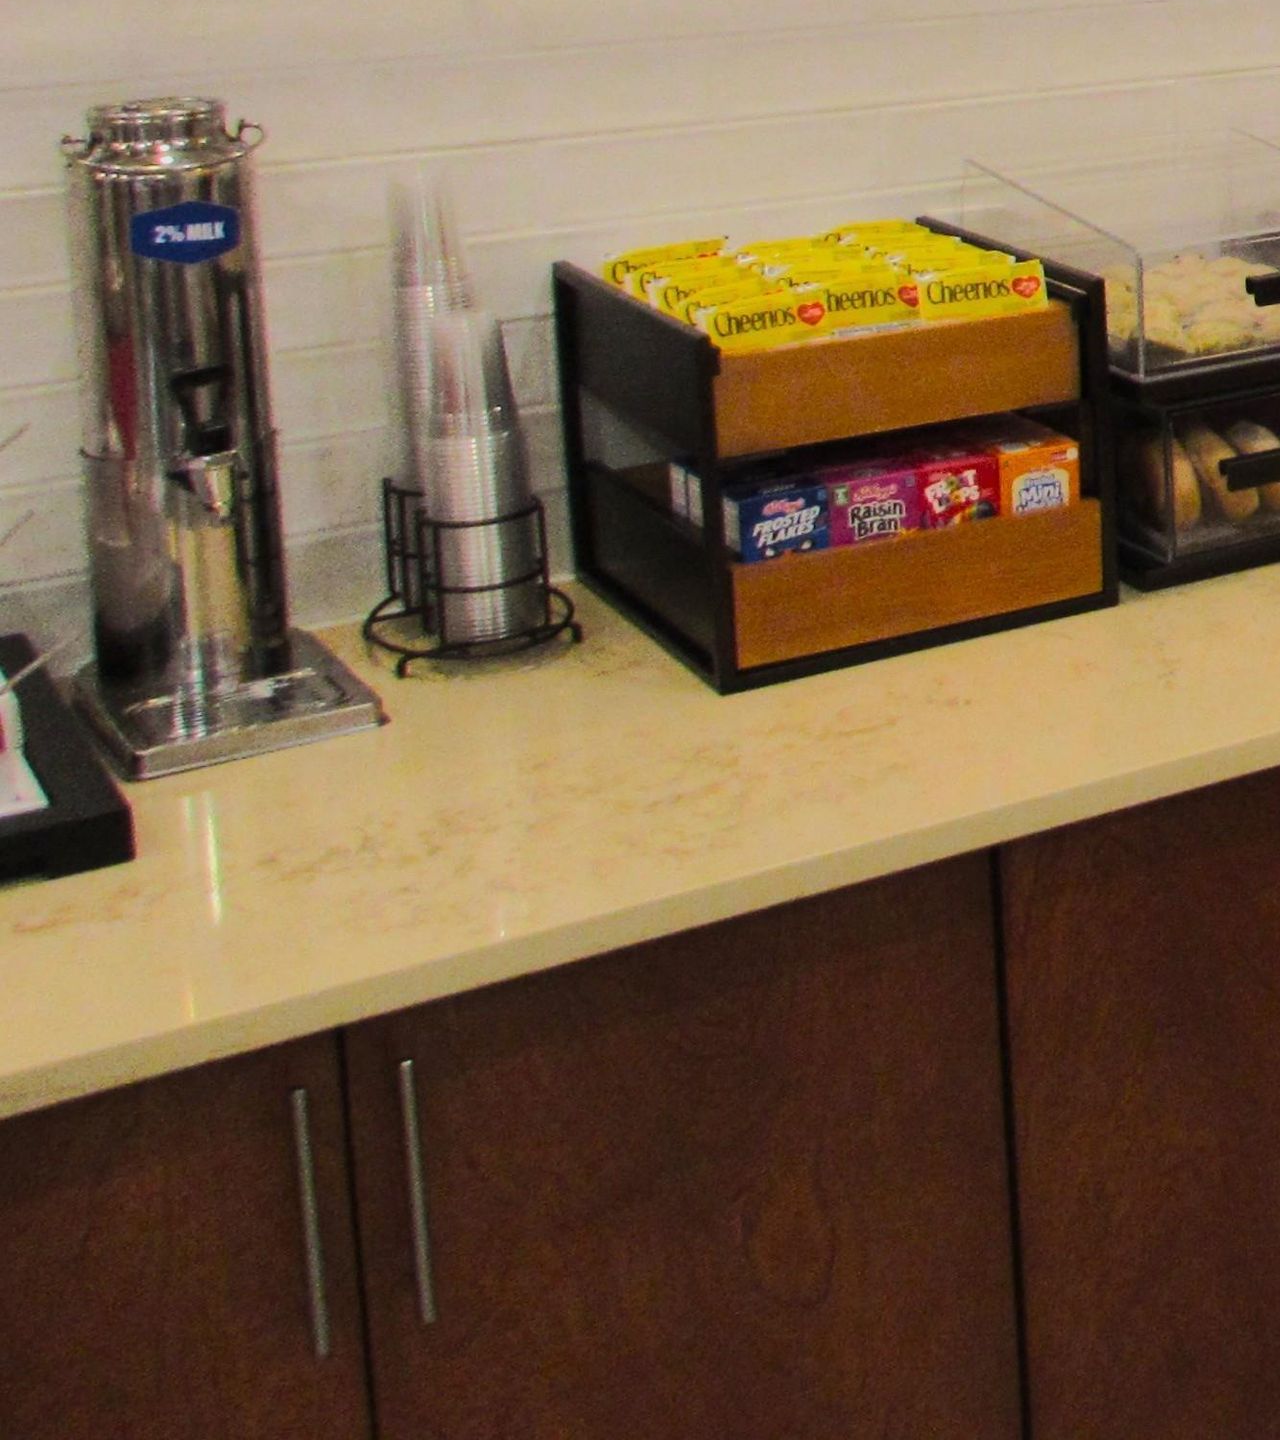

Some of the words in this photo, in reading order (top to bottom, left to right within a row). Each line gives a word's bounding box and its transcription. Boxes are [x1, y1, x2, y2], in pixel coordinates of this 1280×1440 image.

[153, 224, 186, 244] 2%
[925, 278, 1011, 306] Cheerios
[713, 305, 797, 338] Cheerios
[752, 504, 821, 538] FROSTED
[851, 502, 905, 526] Raisin
[857, 517, 899, 538] Bran
[757, 521, 816, 549] FLAKES
